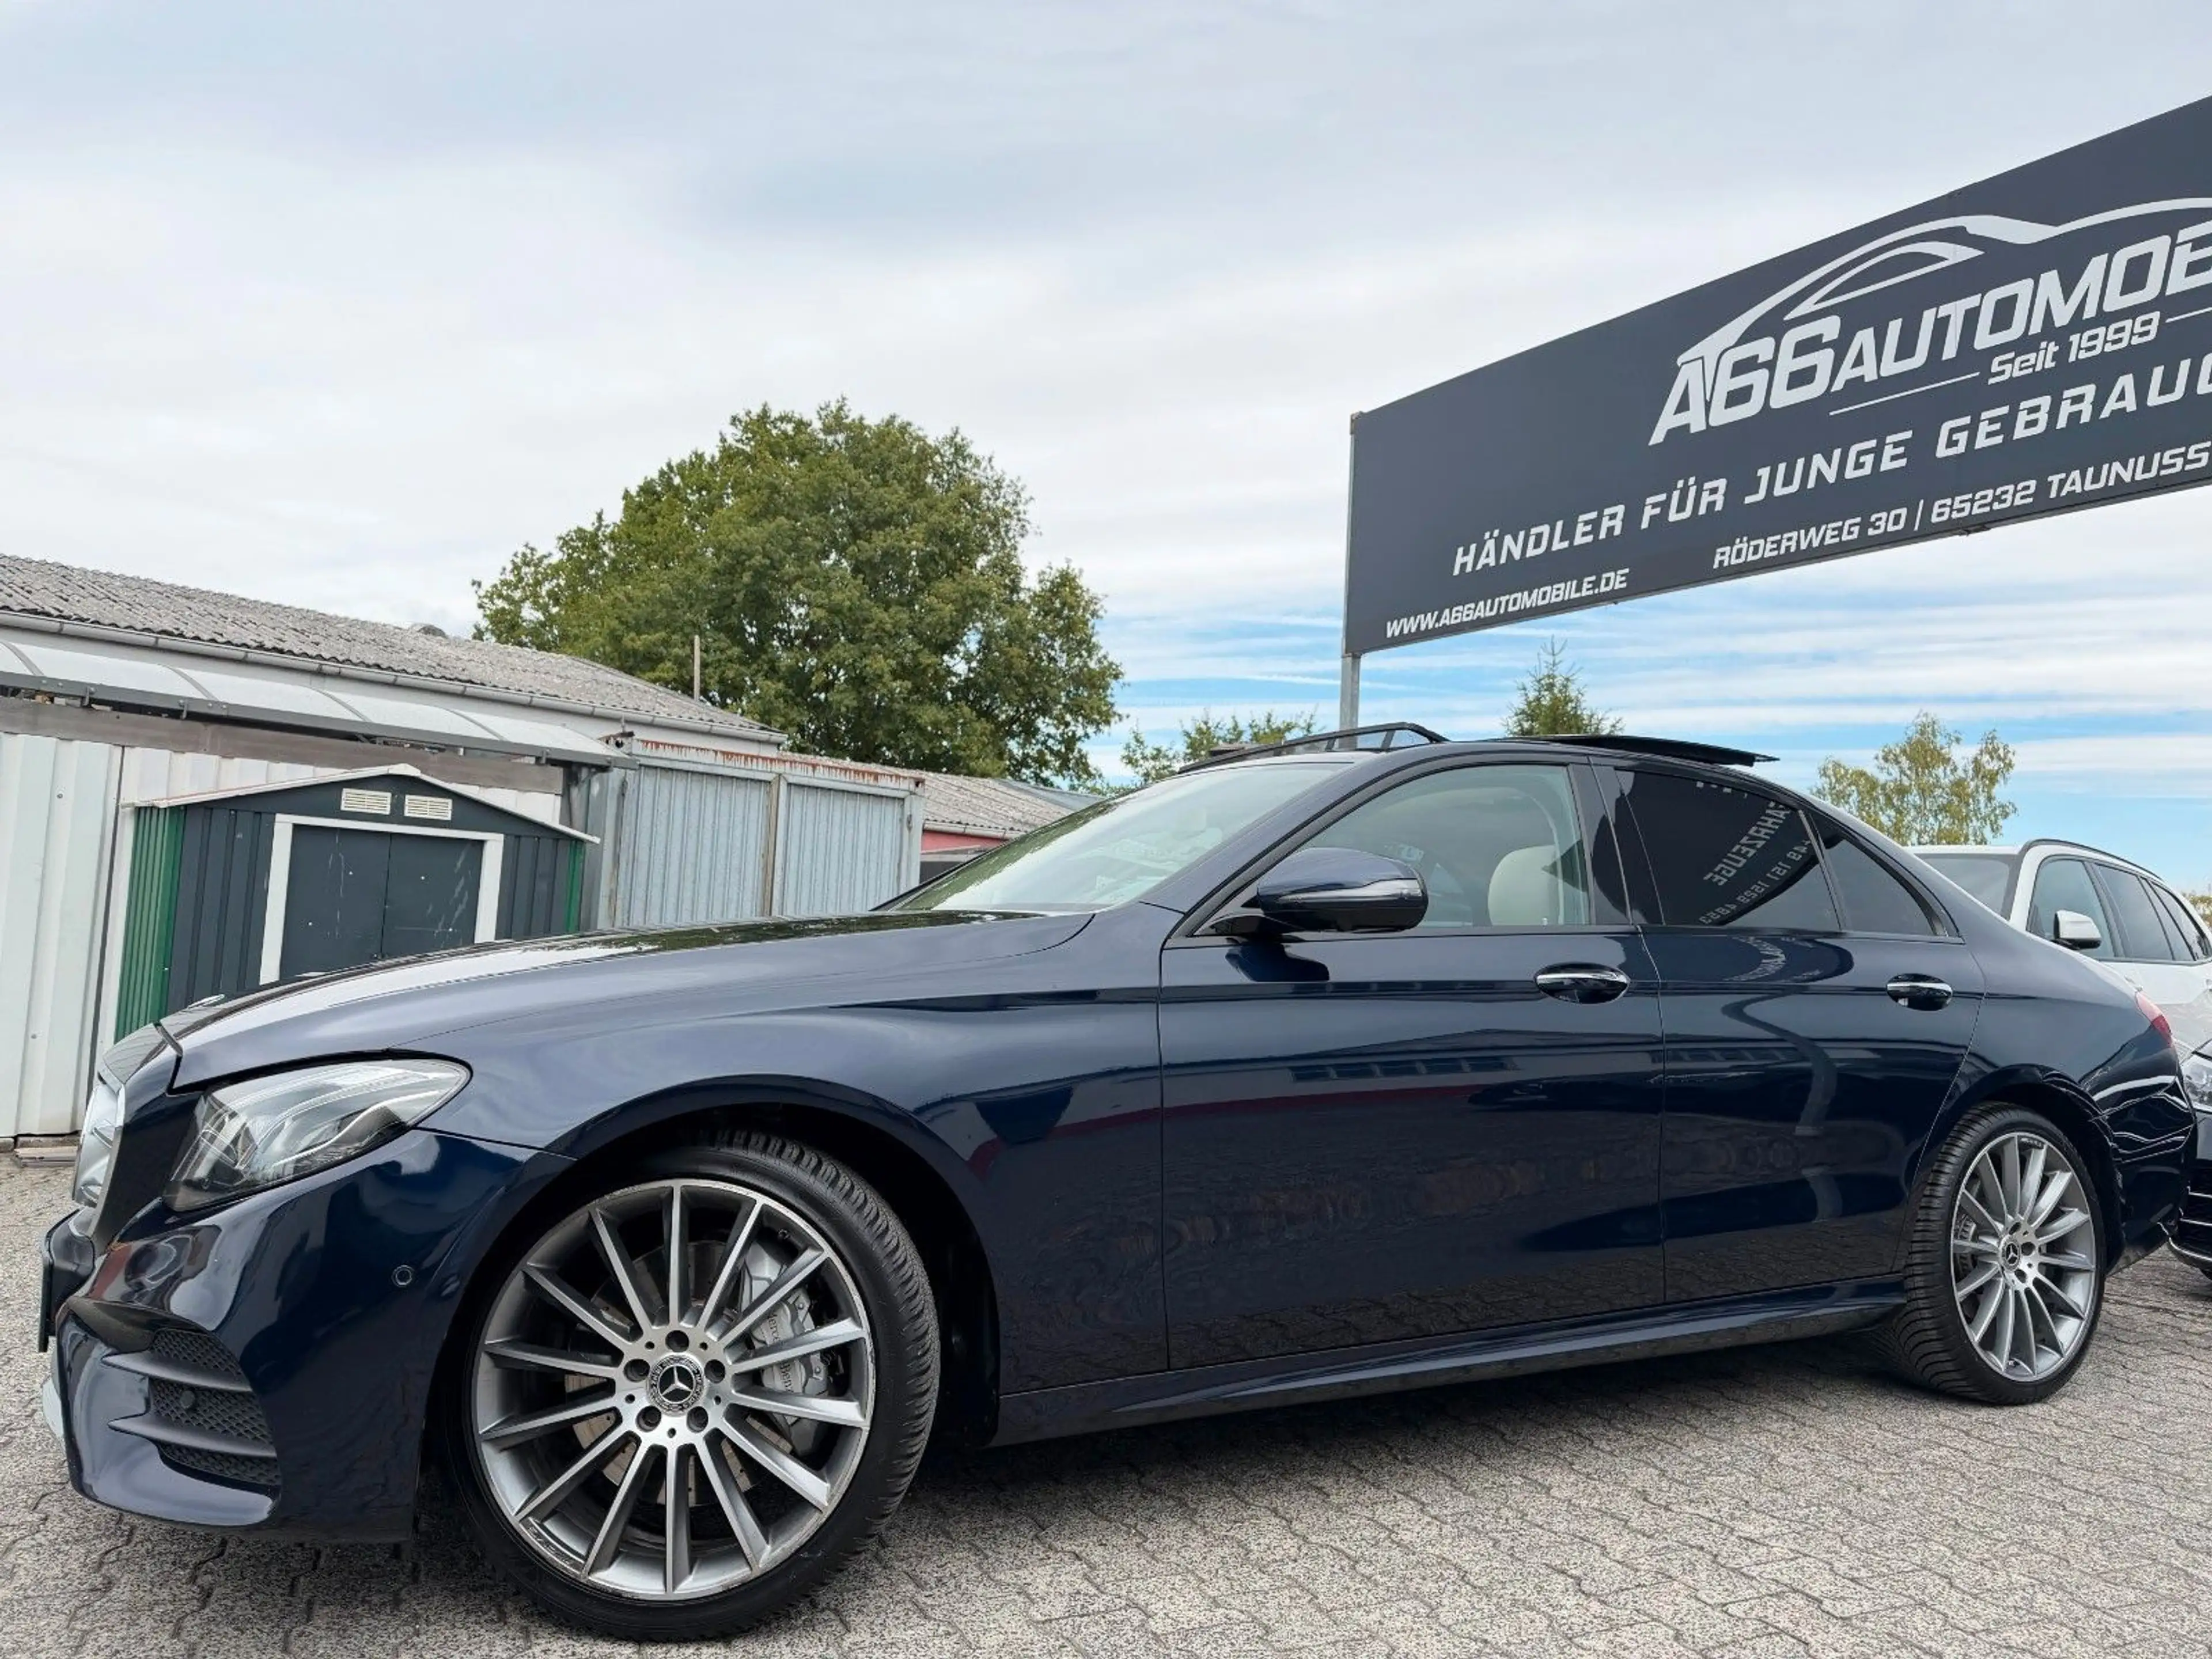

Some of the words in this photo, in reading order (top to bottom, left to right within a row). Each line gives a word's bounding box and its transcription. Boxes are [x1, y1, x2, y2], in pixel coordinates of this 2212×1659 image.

[1988, 341, 2059, 385] Seit
[2069, 311, 2161, 363] 1999
[1453, 504, 1625, 575] HÄNDLER
[1641, 476, 1726, 529] FÜR
[1744, 430, 1912, 504] JUNGE
[1713, 517, 1861, 569] RÖDERWEG
[1868, 507, 1907, 536] 30
[1931, 479, 2036, 524] 65232
[2048, 441, 2211, 499] TAUNUSS
[1385, 568, 1630, 637] WWW.A66AUTOMOBILE.DE
